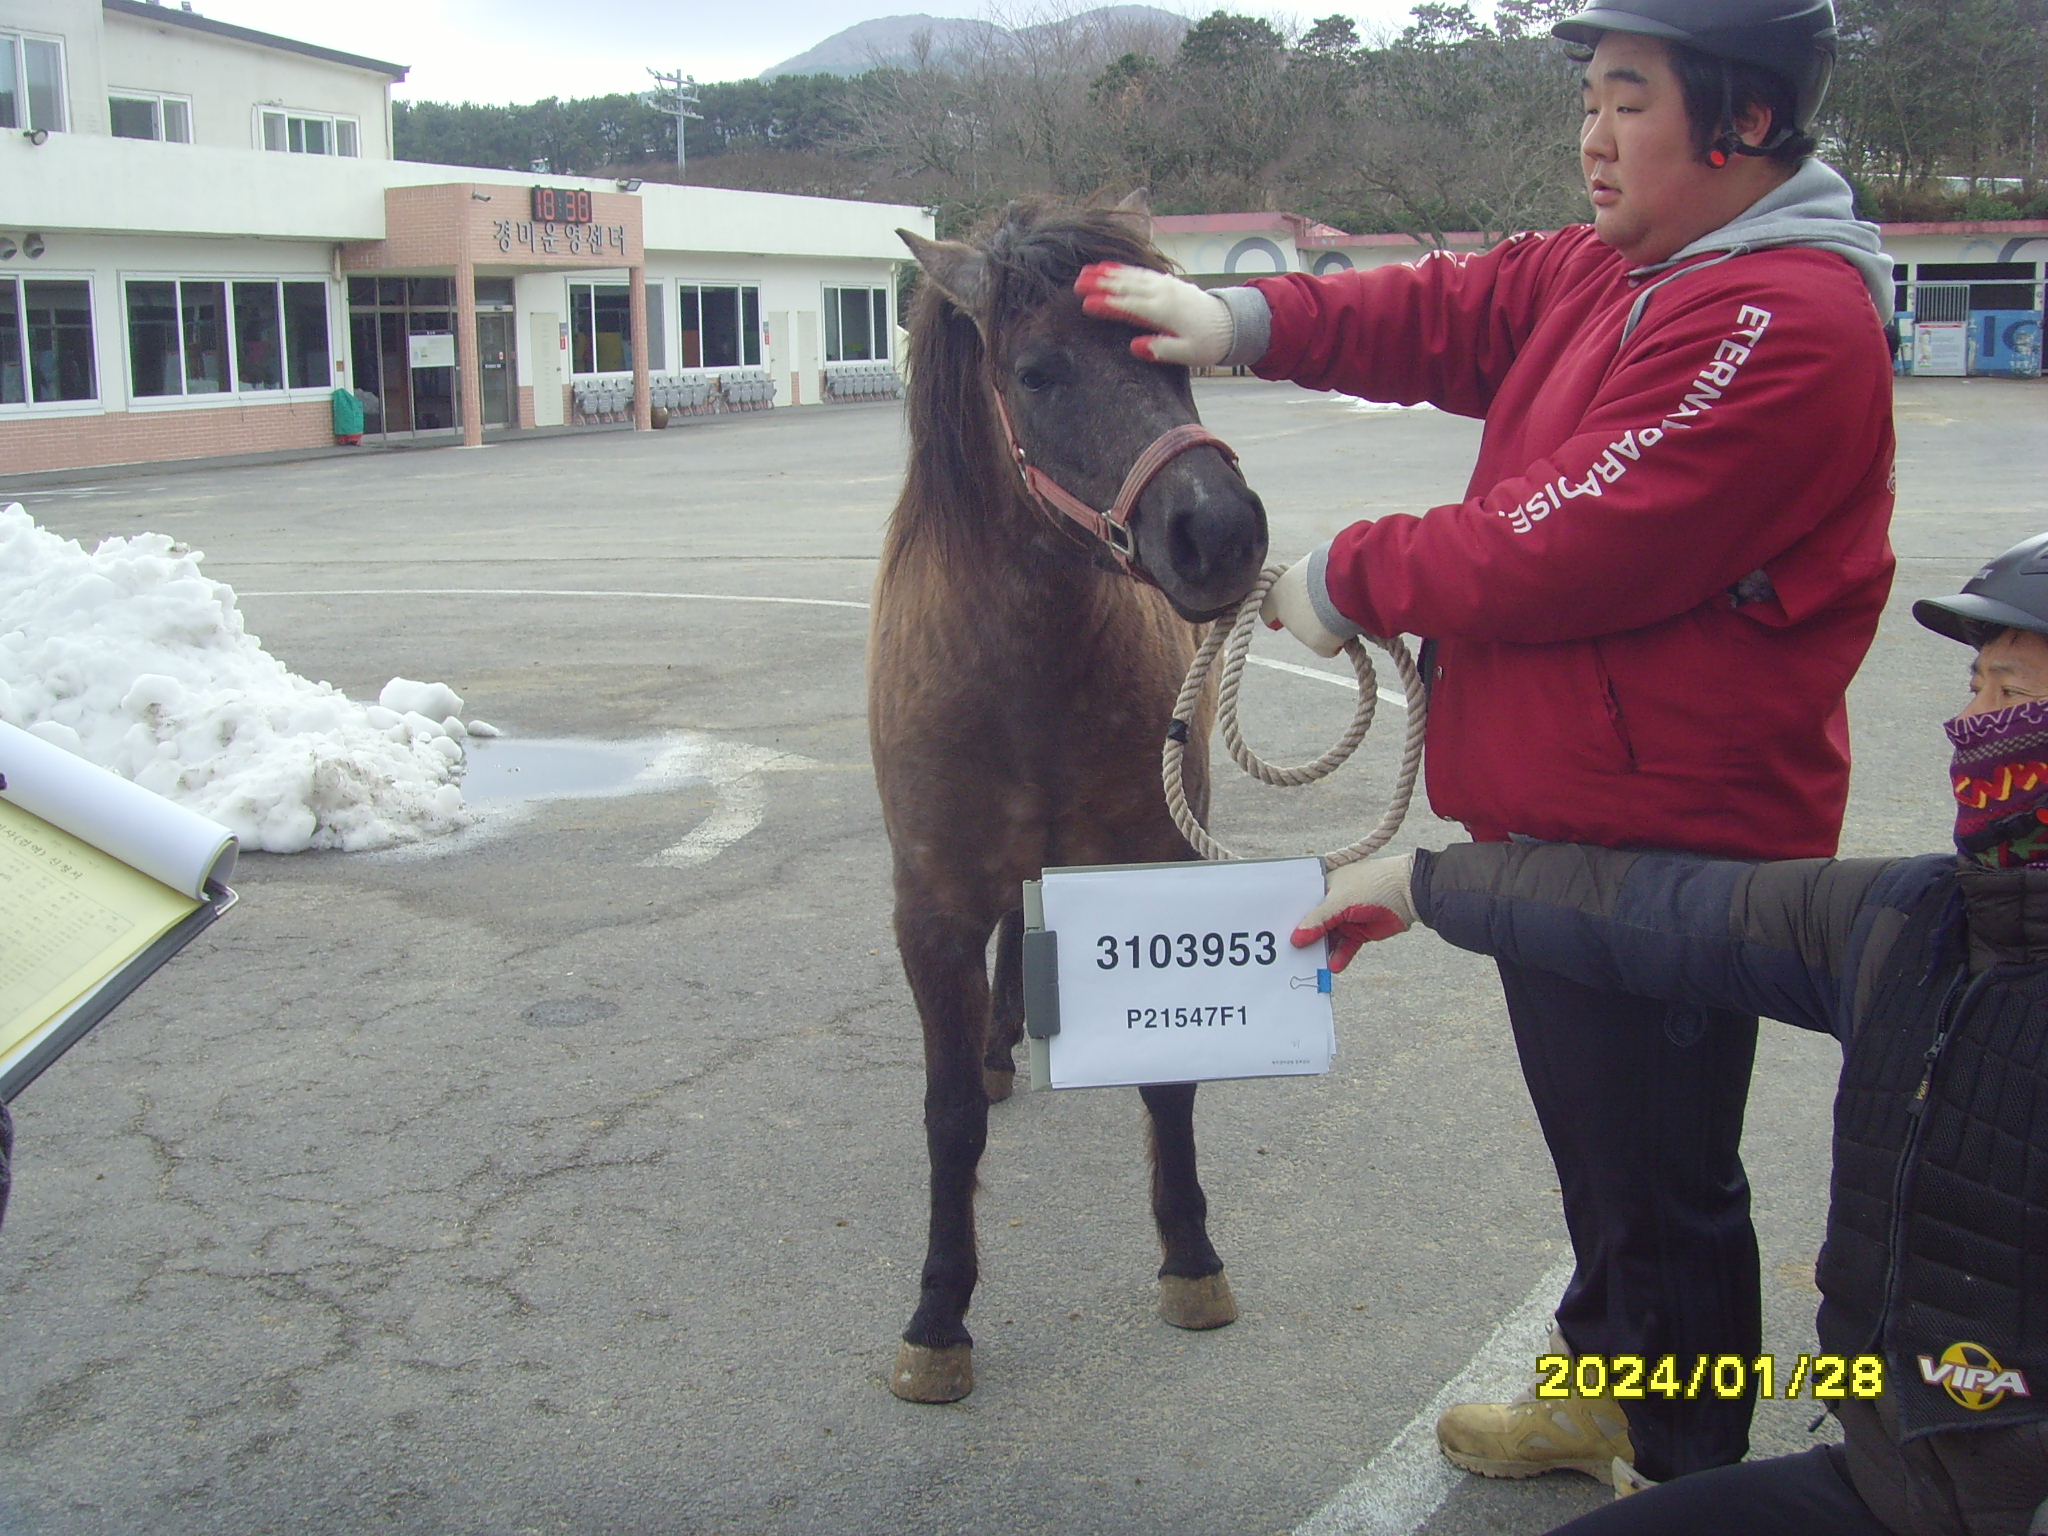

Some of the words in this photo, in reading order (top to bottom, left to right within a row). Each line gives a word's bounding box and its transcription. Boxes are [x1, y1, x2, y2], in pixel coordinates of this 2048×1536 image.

[493, 220, 626, 255] 경마운영센터
[1096, 931, 1277, 970] 3103953
[1127, 1006, 1247, 1029] P21547F1
[1918, 1355, 2030, 1397] VIPA
